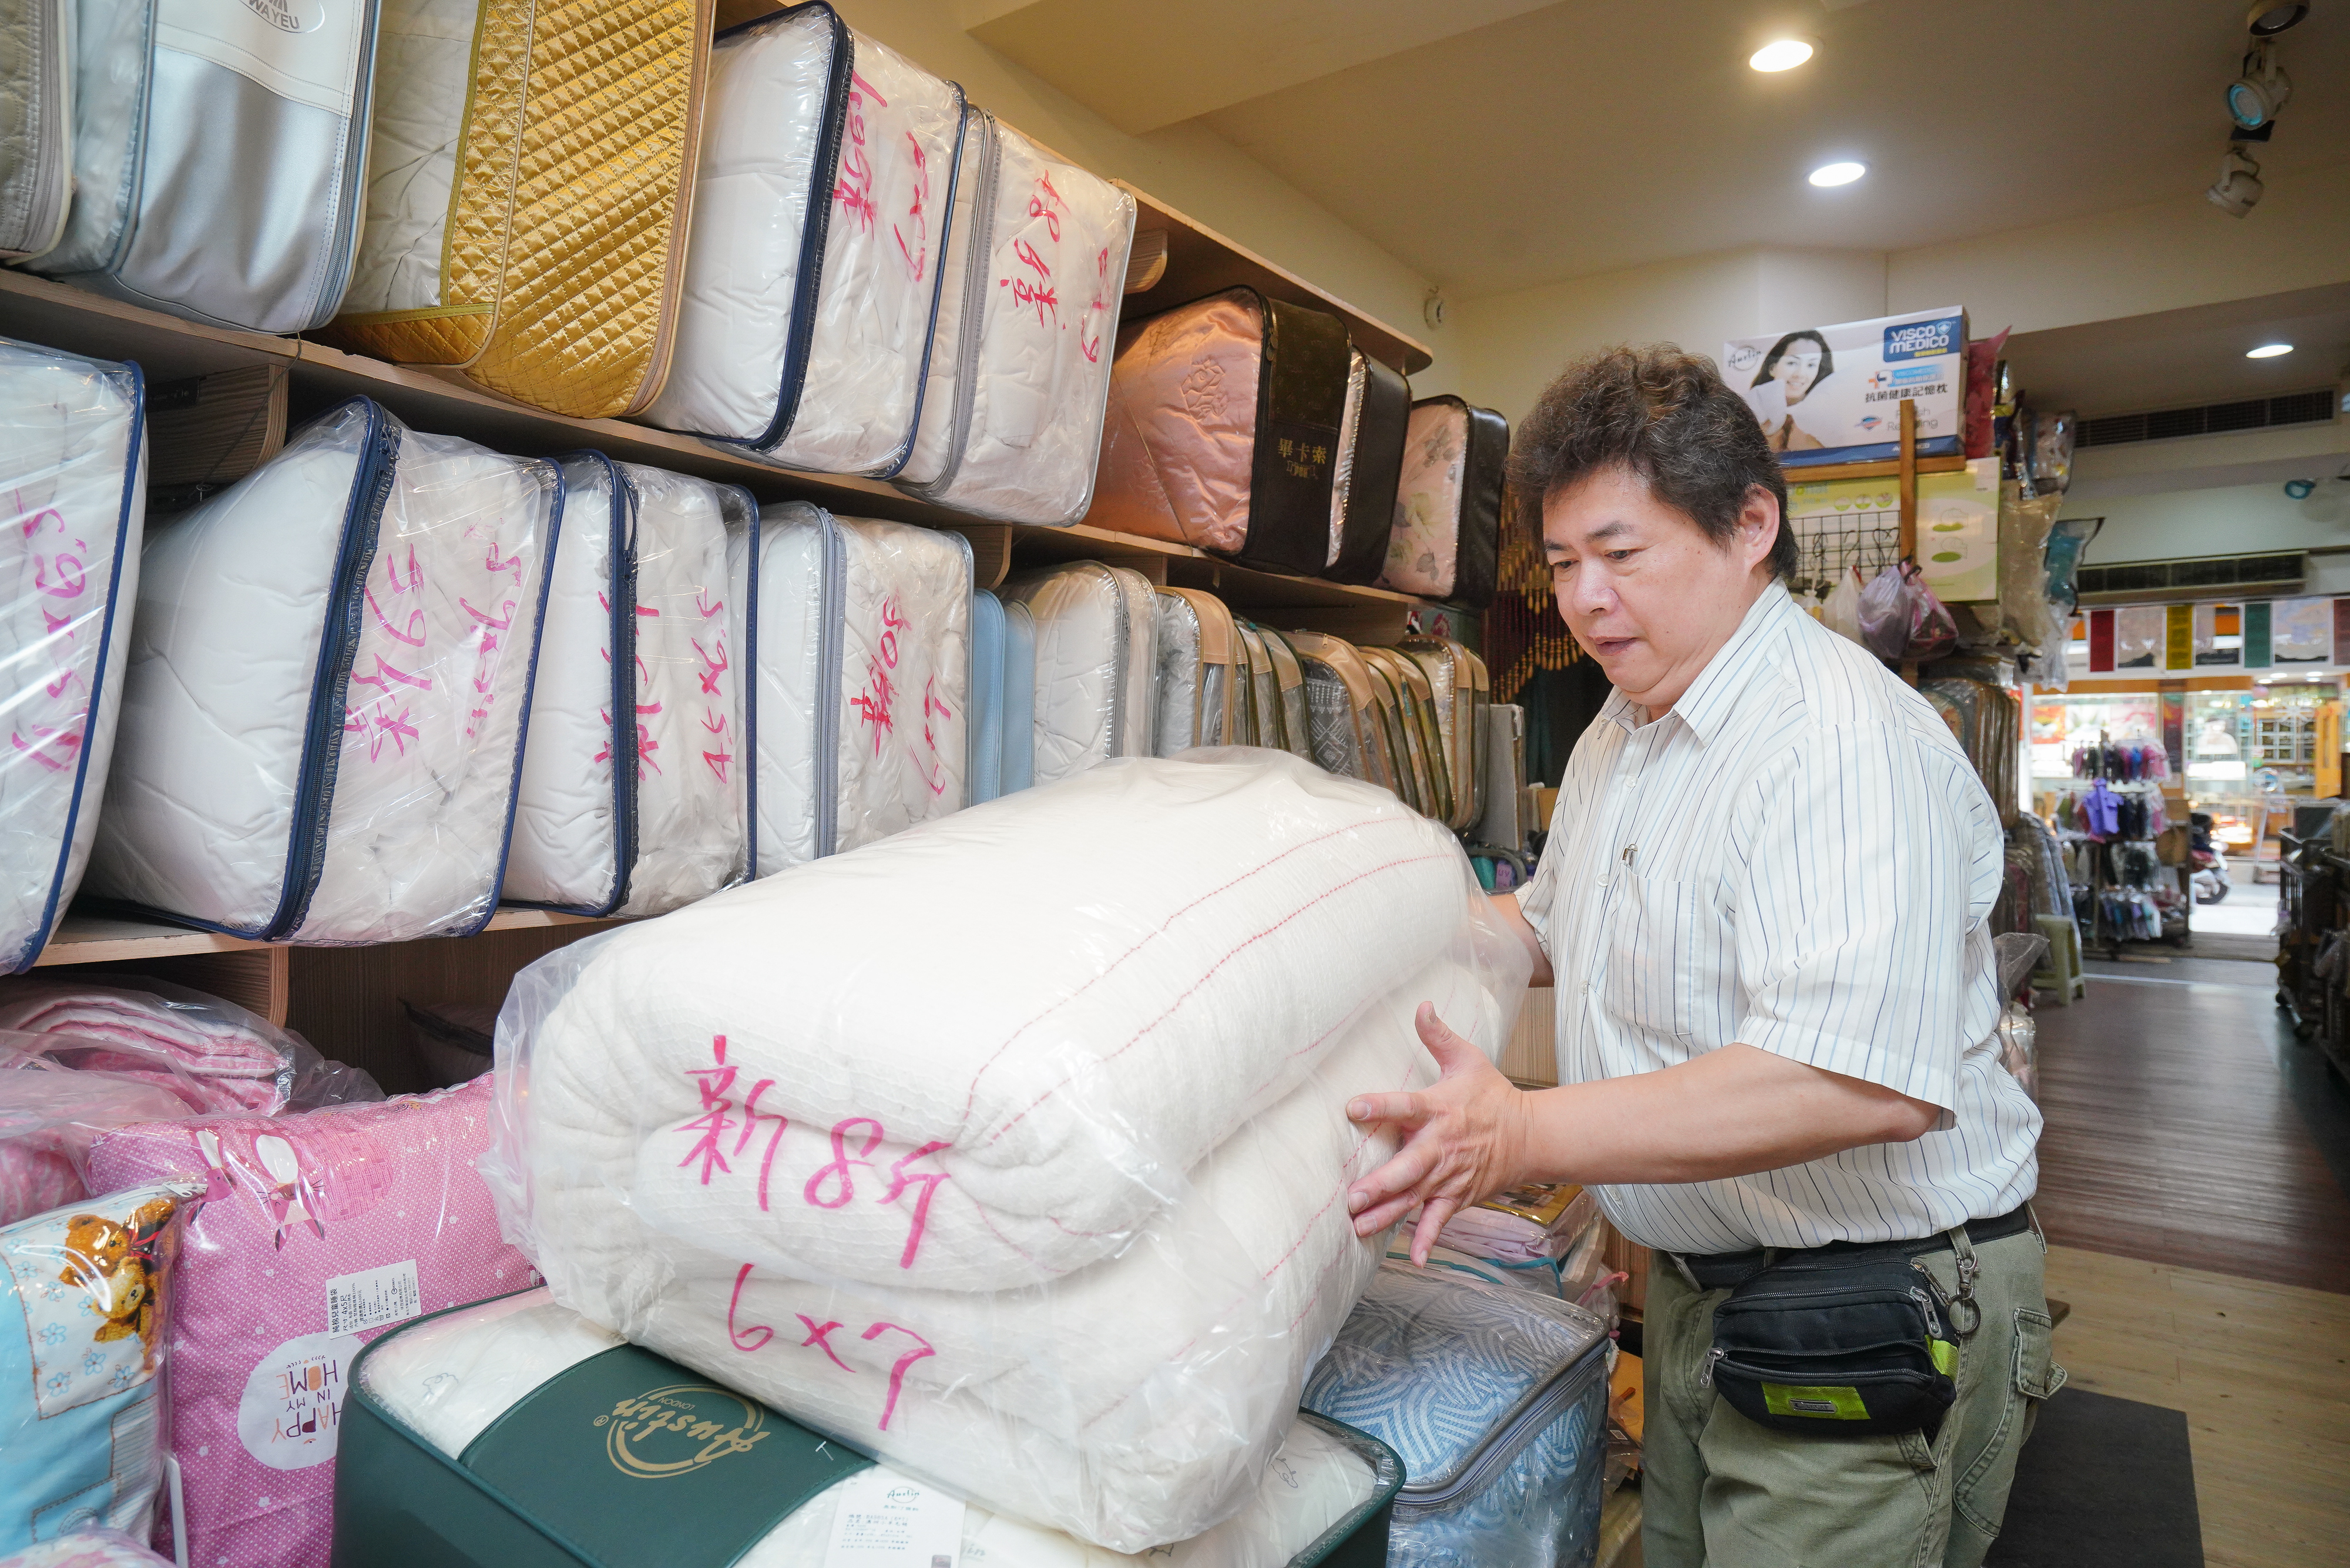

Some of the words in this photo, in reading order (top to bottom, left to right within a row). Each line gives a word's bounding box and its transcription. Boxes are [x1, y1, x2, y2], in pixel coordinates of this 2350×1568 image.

[1890, 324, 1936, 342] VISCO
[1889, 334, 1949, 354] MEDICO
[1865, 383, 1948, 403] 抗菌健康記憶枕
[1278, 438, 1327, 464] 畢卡索
[329, 1288, 340, 1334] 純棉兒童睡袋
[276, 1359, 338, 1400] HOME
[286, 1397, 306, 1412] MY
[317, 1388, 330, 1404] IN
[657, 1396, 696, 1411] LONDON
[272, 1402, 341, 1444] HAPPY
[612, 1398, 771, 1463] Austin
[887, 1490, 921, 1499] Austin
